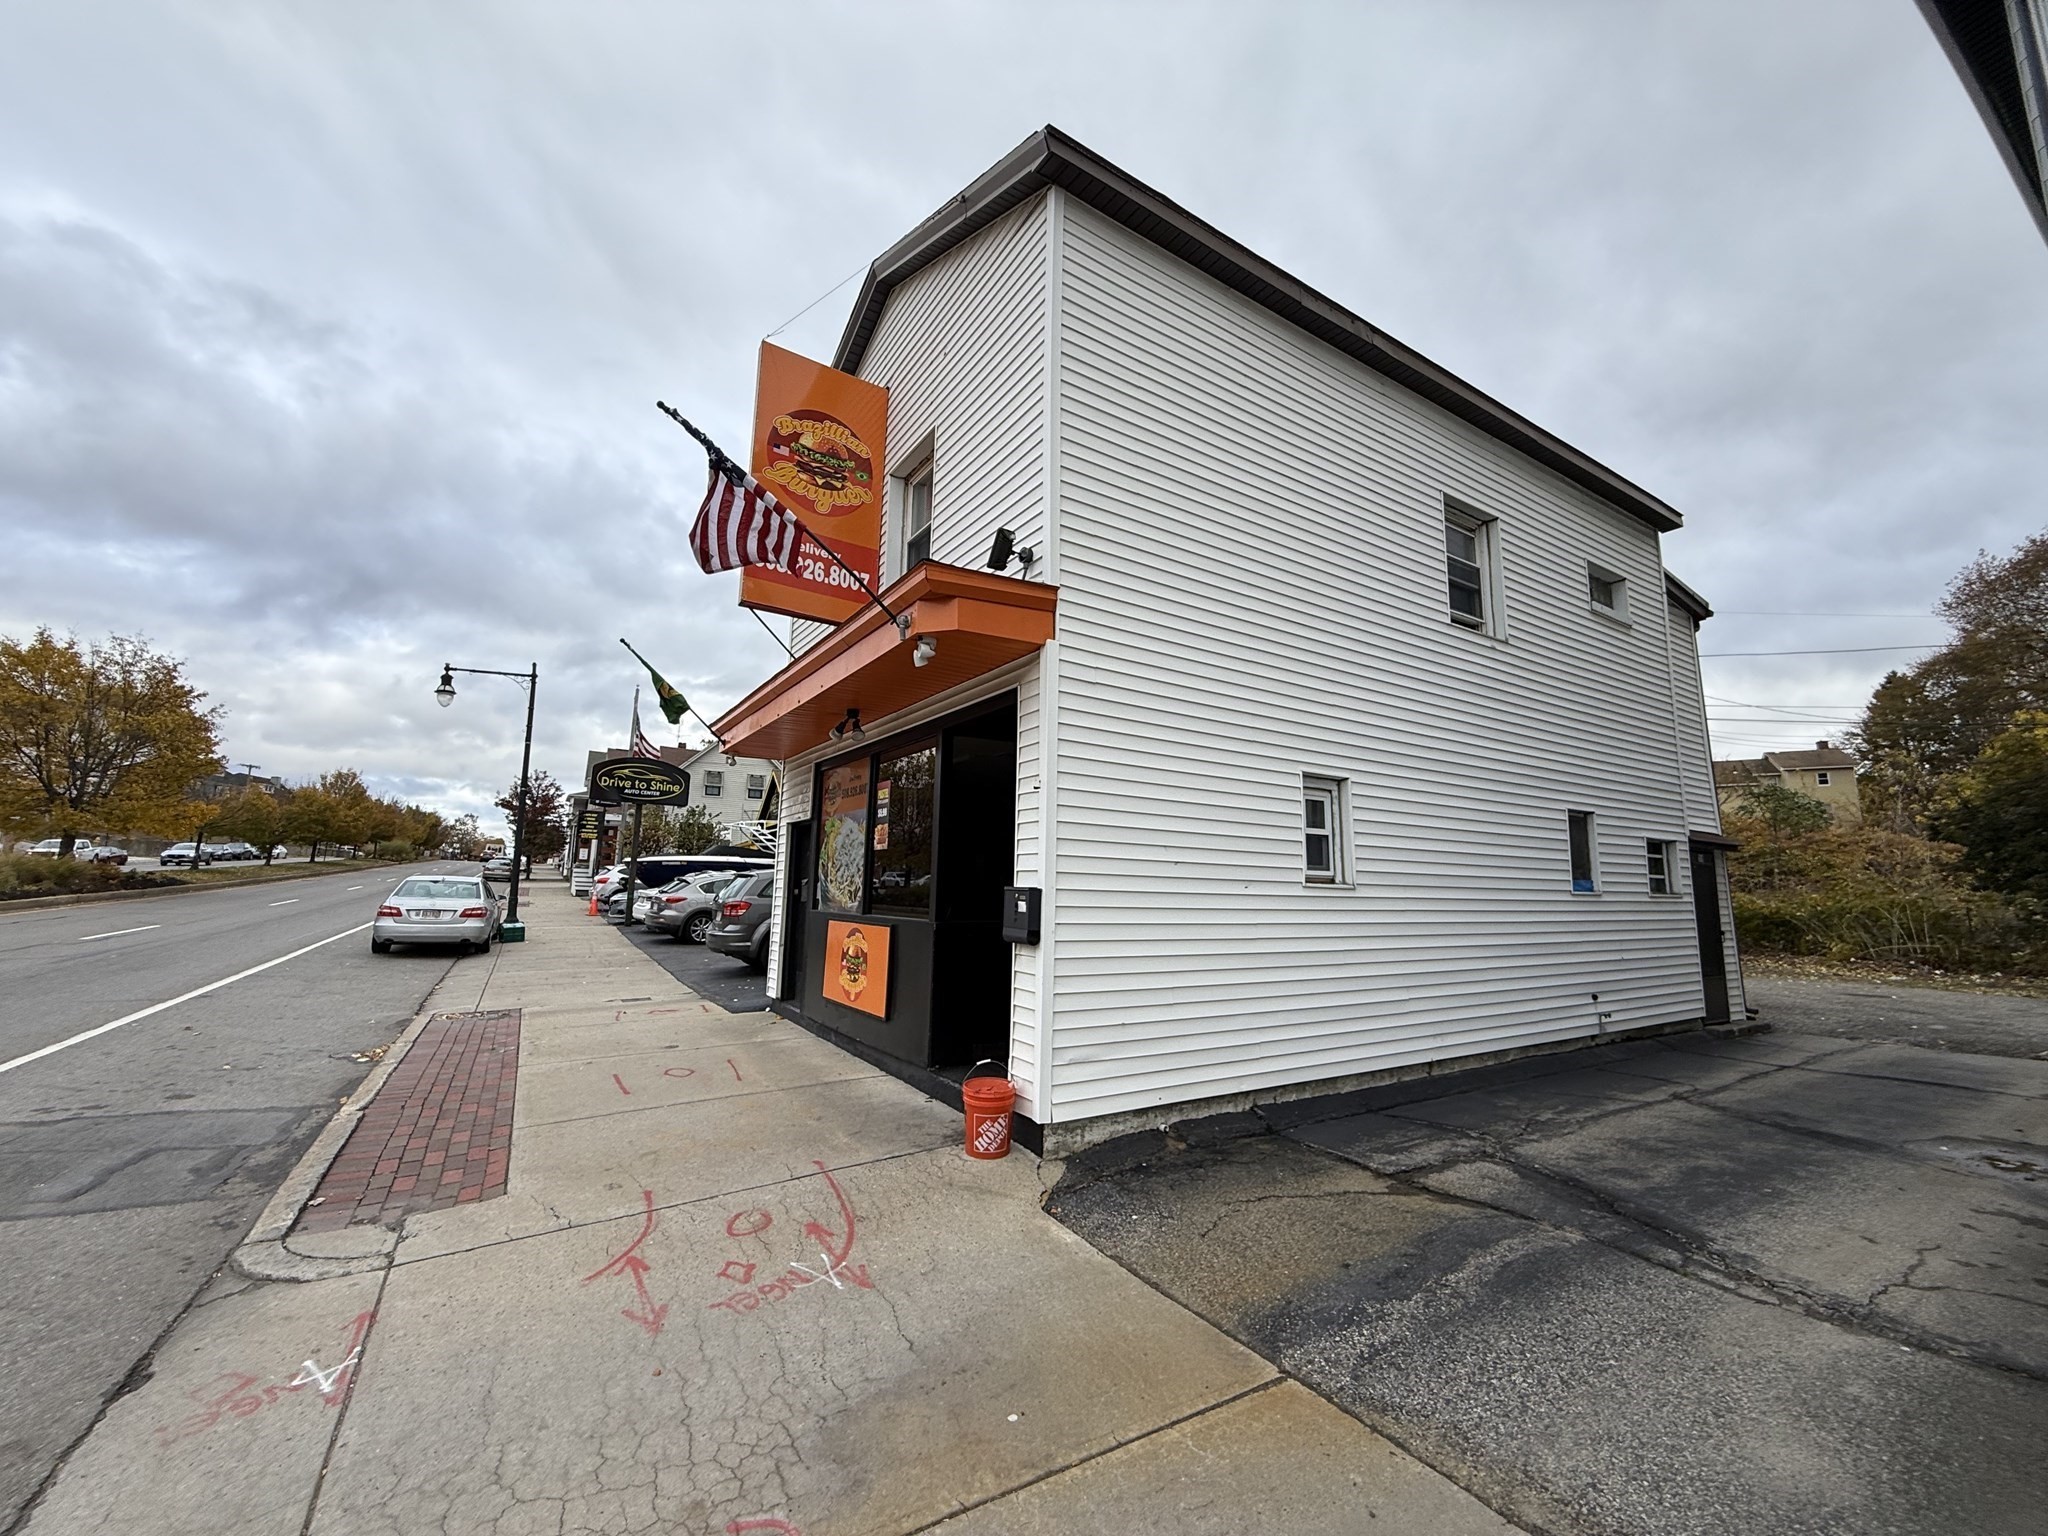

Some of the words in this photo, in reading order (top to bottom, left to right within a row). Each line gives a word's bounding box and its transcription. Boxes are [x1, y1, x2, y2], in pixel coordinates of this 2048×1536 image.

[773, 415, 871, 458] Brazillian
[762, 461, 873, 513] Burguer
[601, 776, 632, 789] Drive
[635, 781, 647, 789] to
[650, 780, 680, 792] Shine
[974, 1113, 1009, 1152] HOME
[977, 1119, 994, 1134] THE
